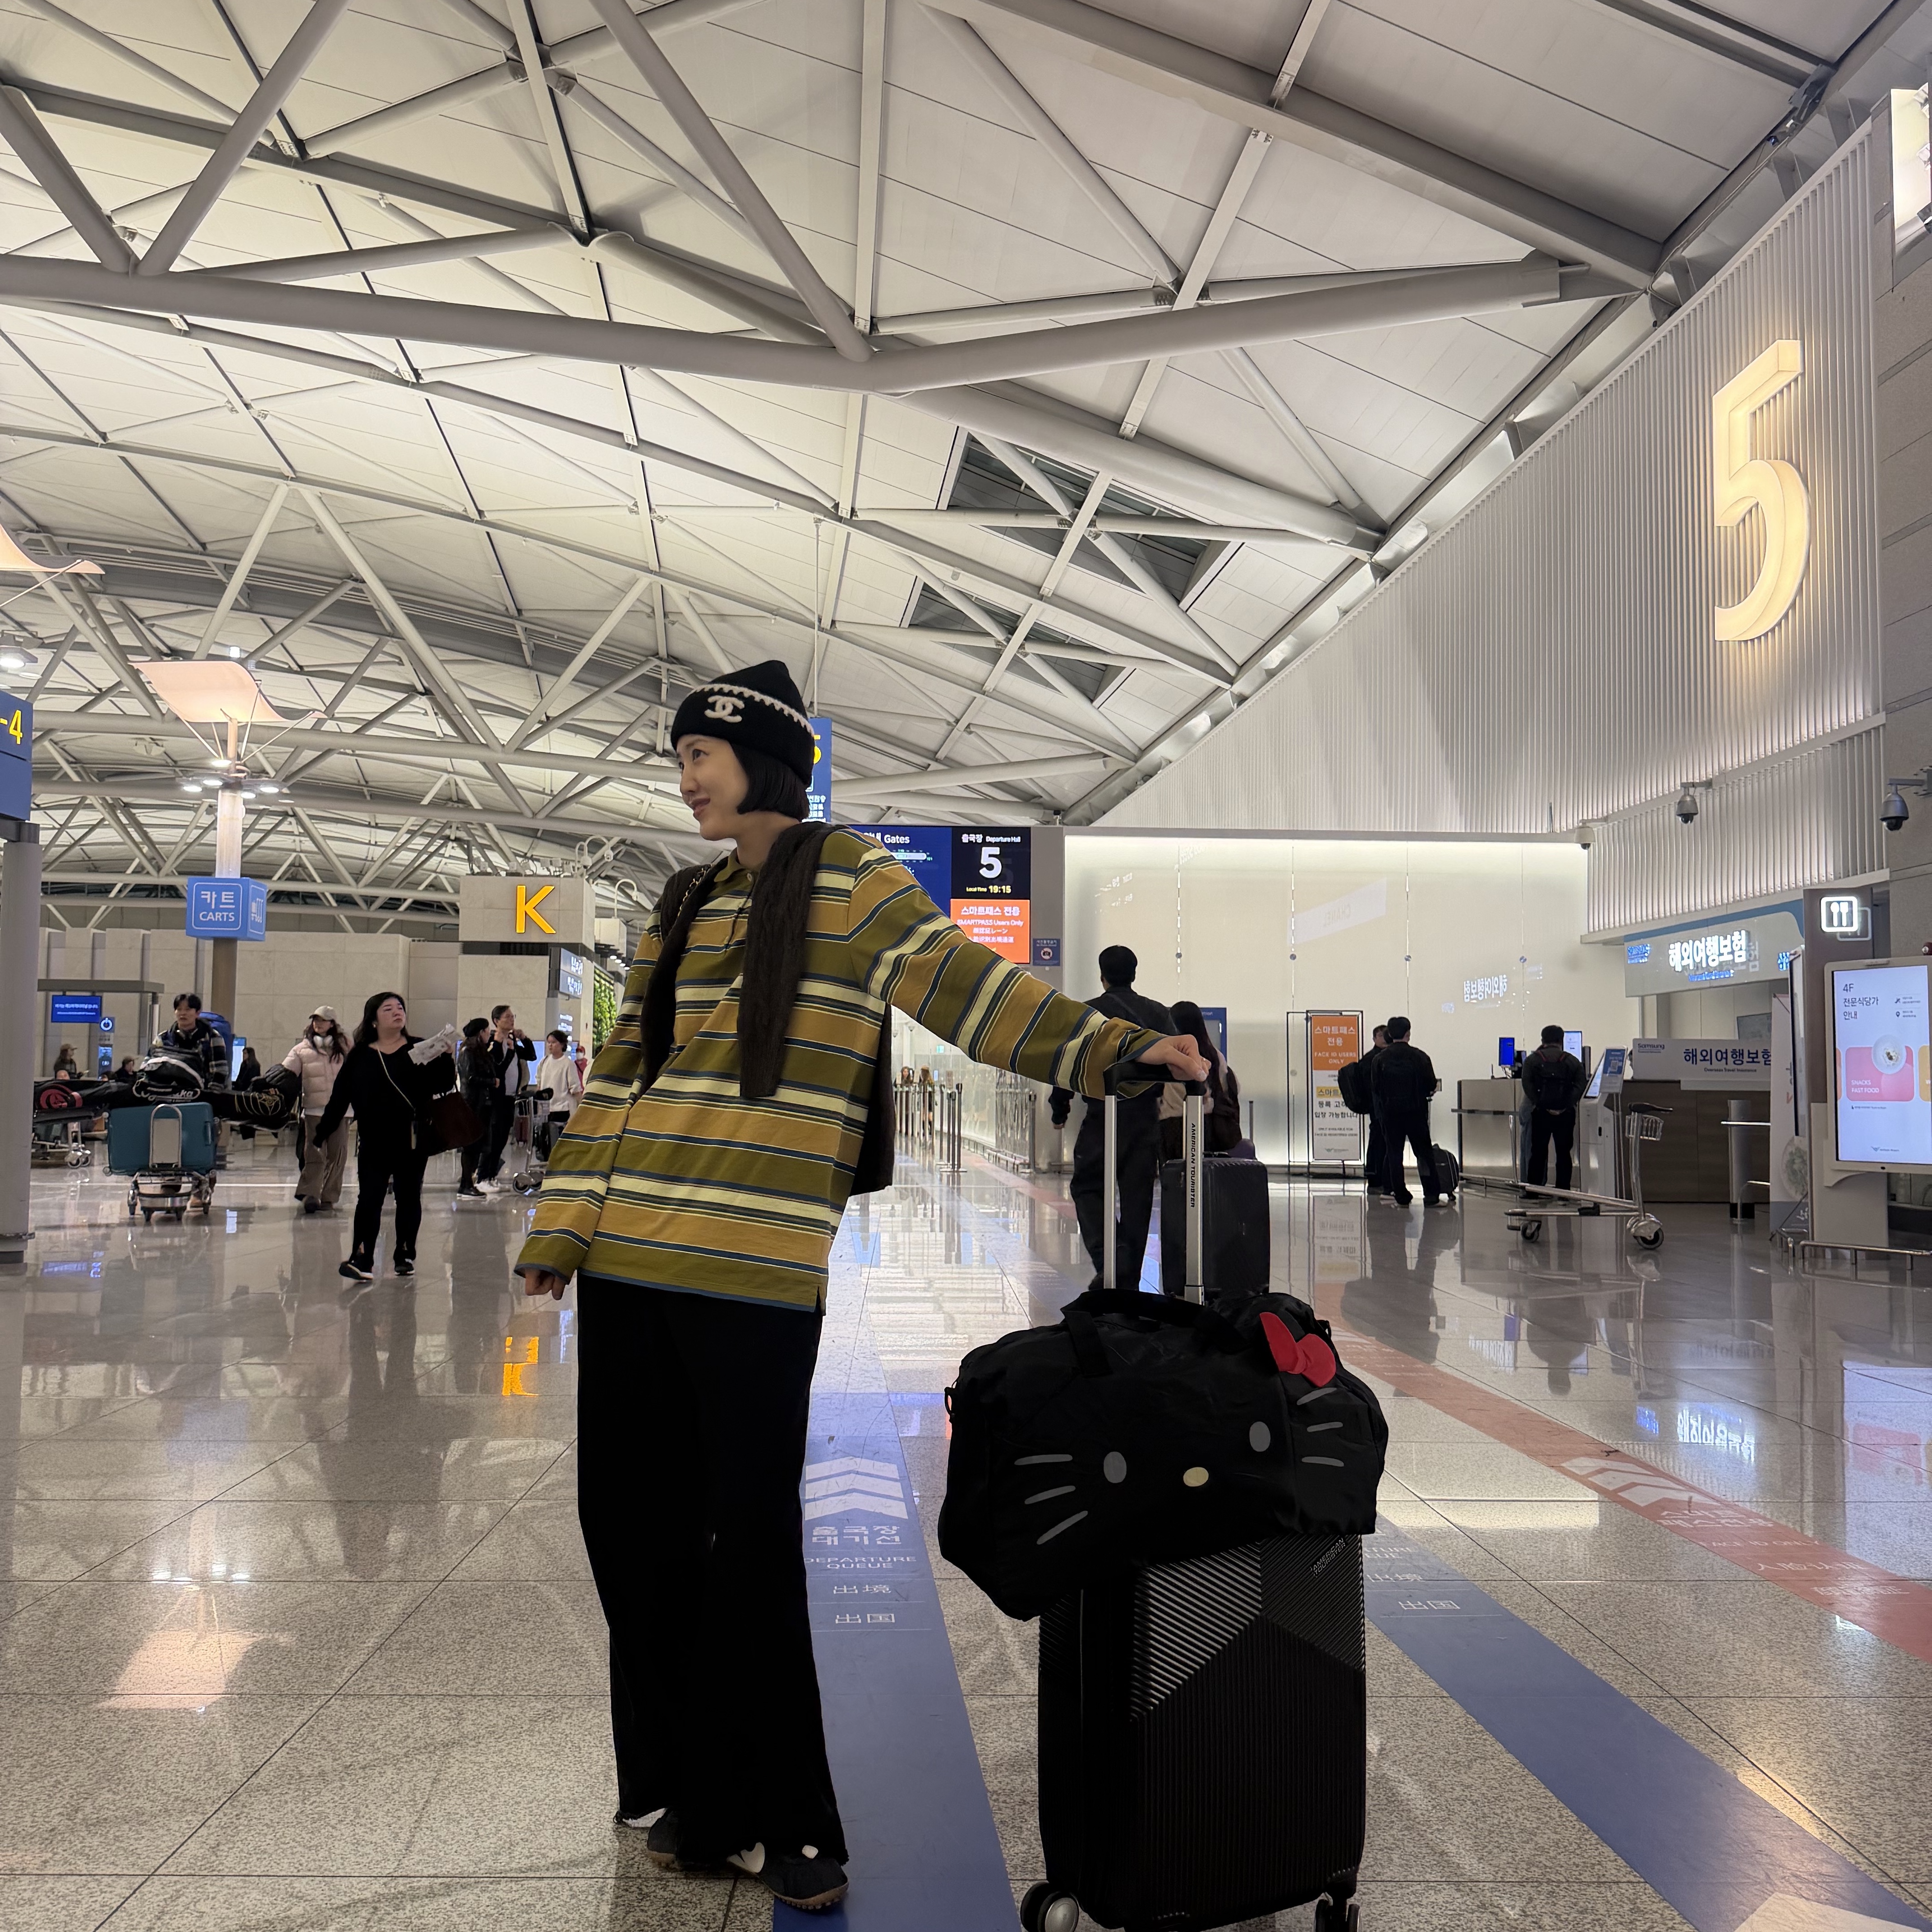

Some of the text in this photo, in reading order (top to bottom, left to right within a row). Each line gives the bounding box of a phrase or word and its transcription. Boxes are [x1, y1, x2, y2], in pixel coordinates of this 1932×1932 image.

[1712, 339, 1810, 641] 5
[884, 834, 910, 844] Gates
[961, 834, 983, 843] 출국장
[979, 847, 1002, 879] 5
[989, 885, 1012, 893] 19:15
[201, 891, 235, 909] 카트
[516, 885, 556, 934] K
[961, 906, 1021, 916] 스마트패스 전용
[199, 911, 235, 921] CARTS
[1010, 919, 1024, 927] Only
[1669, 930, 1747, 971] 해외여행보험
[1843, 983, 1854, 992] 4F
[1843, 997, 1879, 1007] 전문식당가
[1843, 1011, 1857, 1020] 안내
[1314, 1026, 1356, 1035] 스마트패스
[1327, 1037, 1343, 1046] 전용
[813, 1526, 900, 1535] 출국장
[812, 1536, 902, 1545] 대기선
[1313, 1537, 1343, 1571] AMERICAN
[1314, 1542, 1345, 1574] TOURISTER
[1398, 1601, 1461, 1610] 出国
[836, 1614, 895, 1624] 出国
